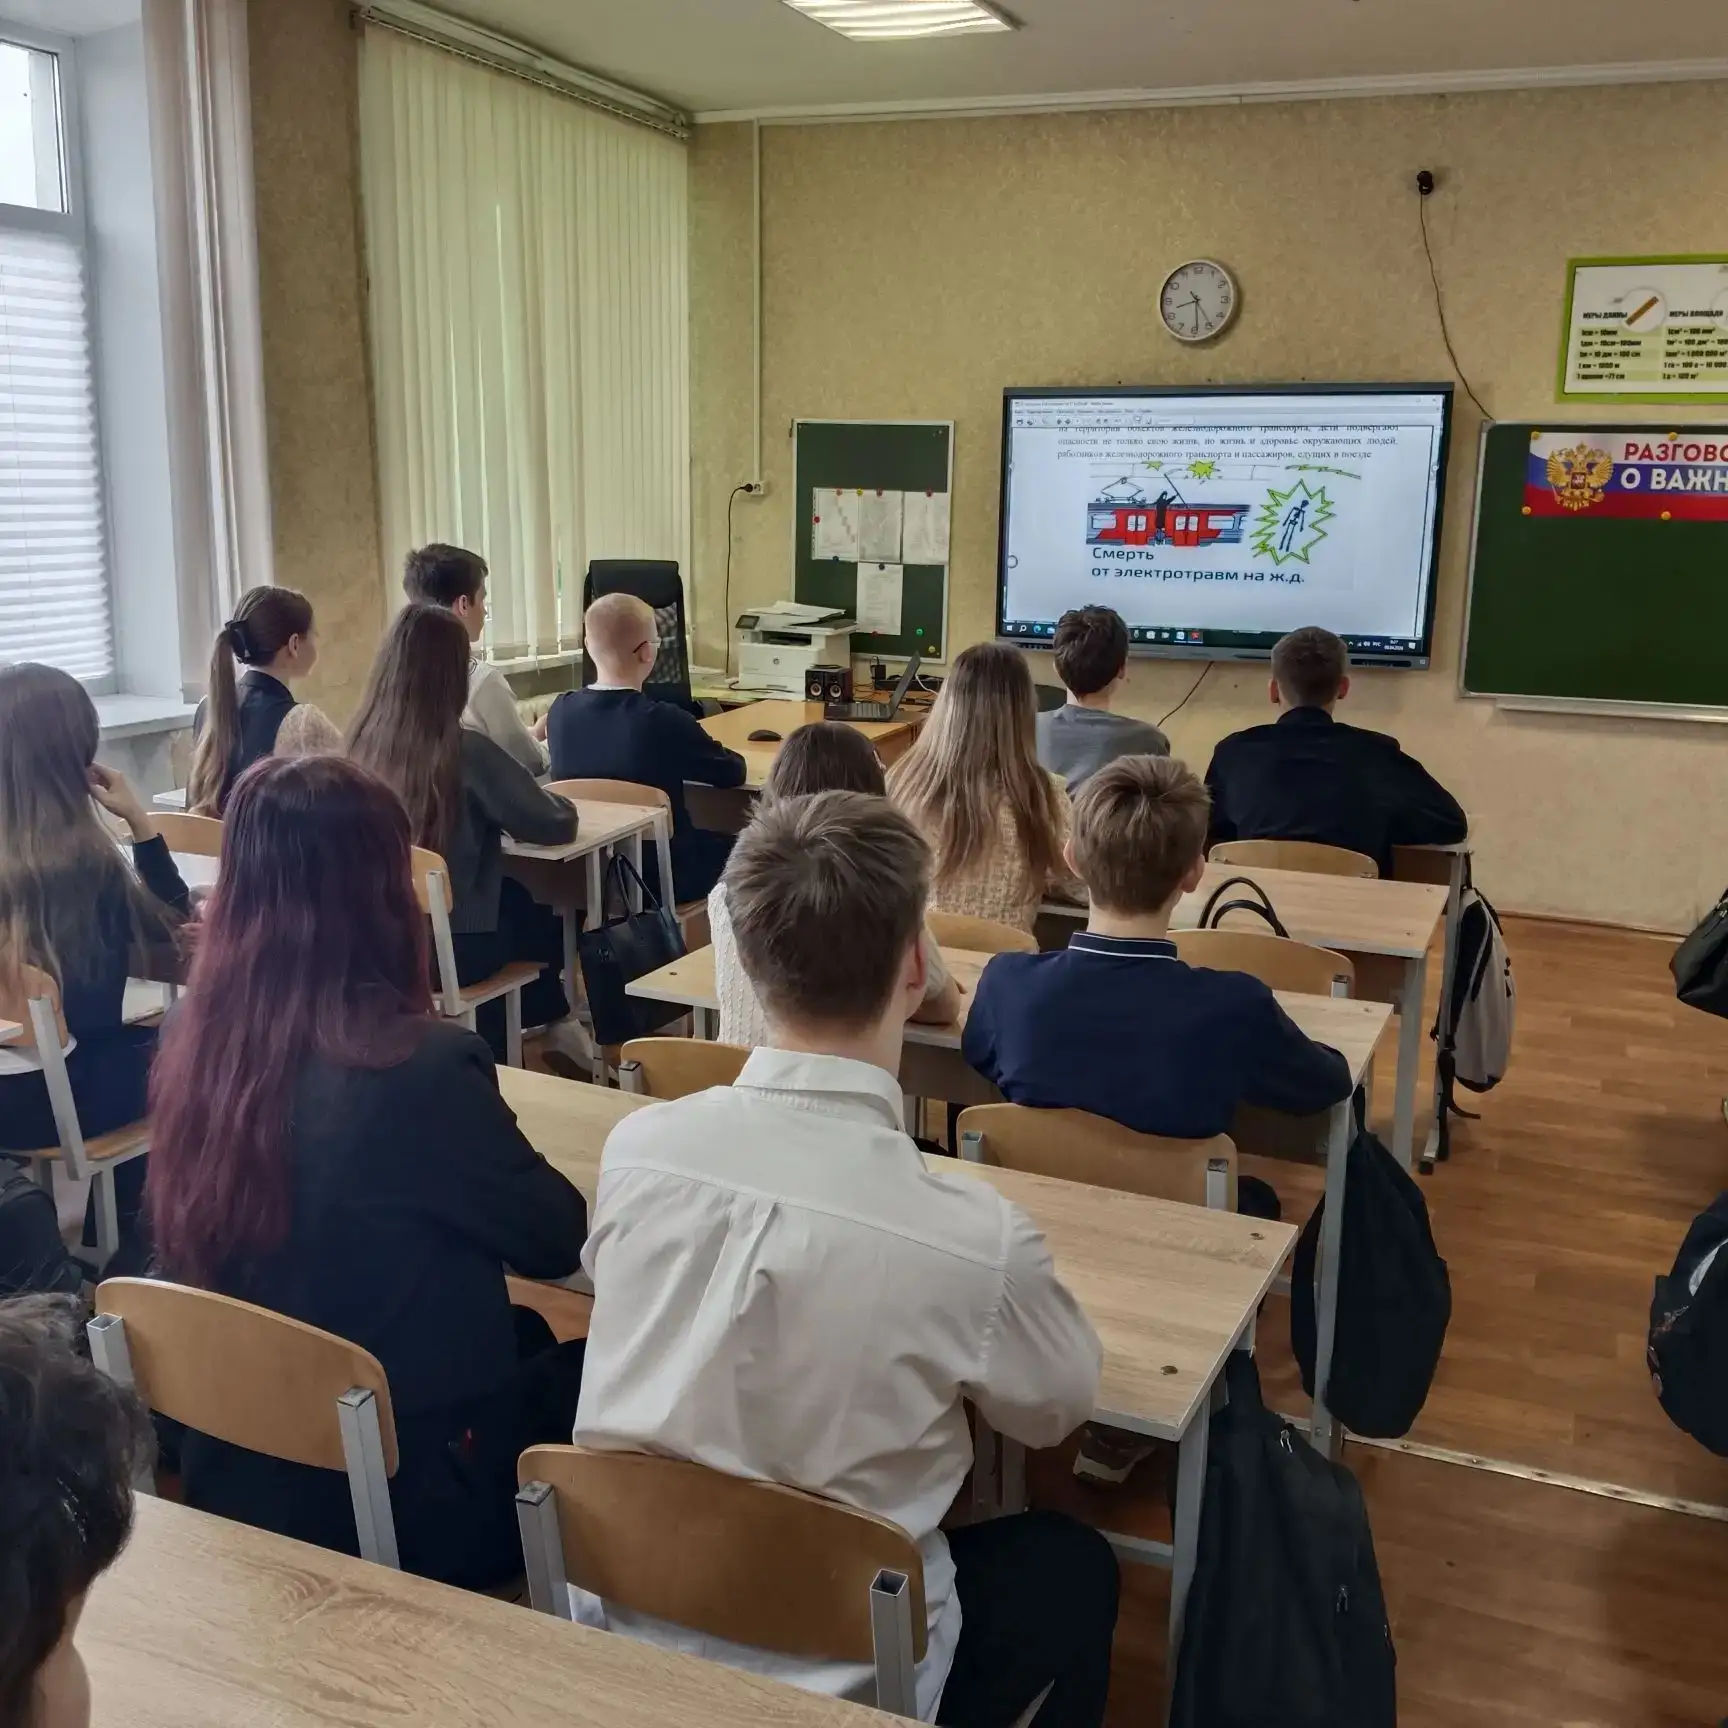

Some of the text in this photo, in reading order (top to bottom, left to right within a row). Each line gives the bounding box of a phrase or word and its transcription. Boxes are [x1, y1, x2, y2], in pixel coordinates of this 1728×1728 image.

[1620, 468, 1728, 490] О ВАЖН
[1092, 548, 1154, 562] Смерть
[1091, 567, 1305, 583] от электротравм на ж.д.
